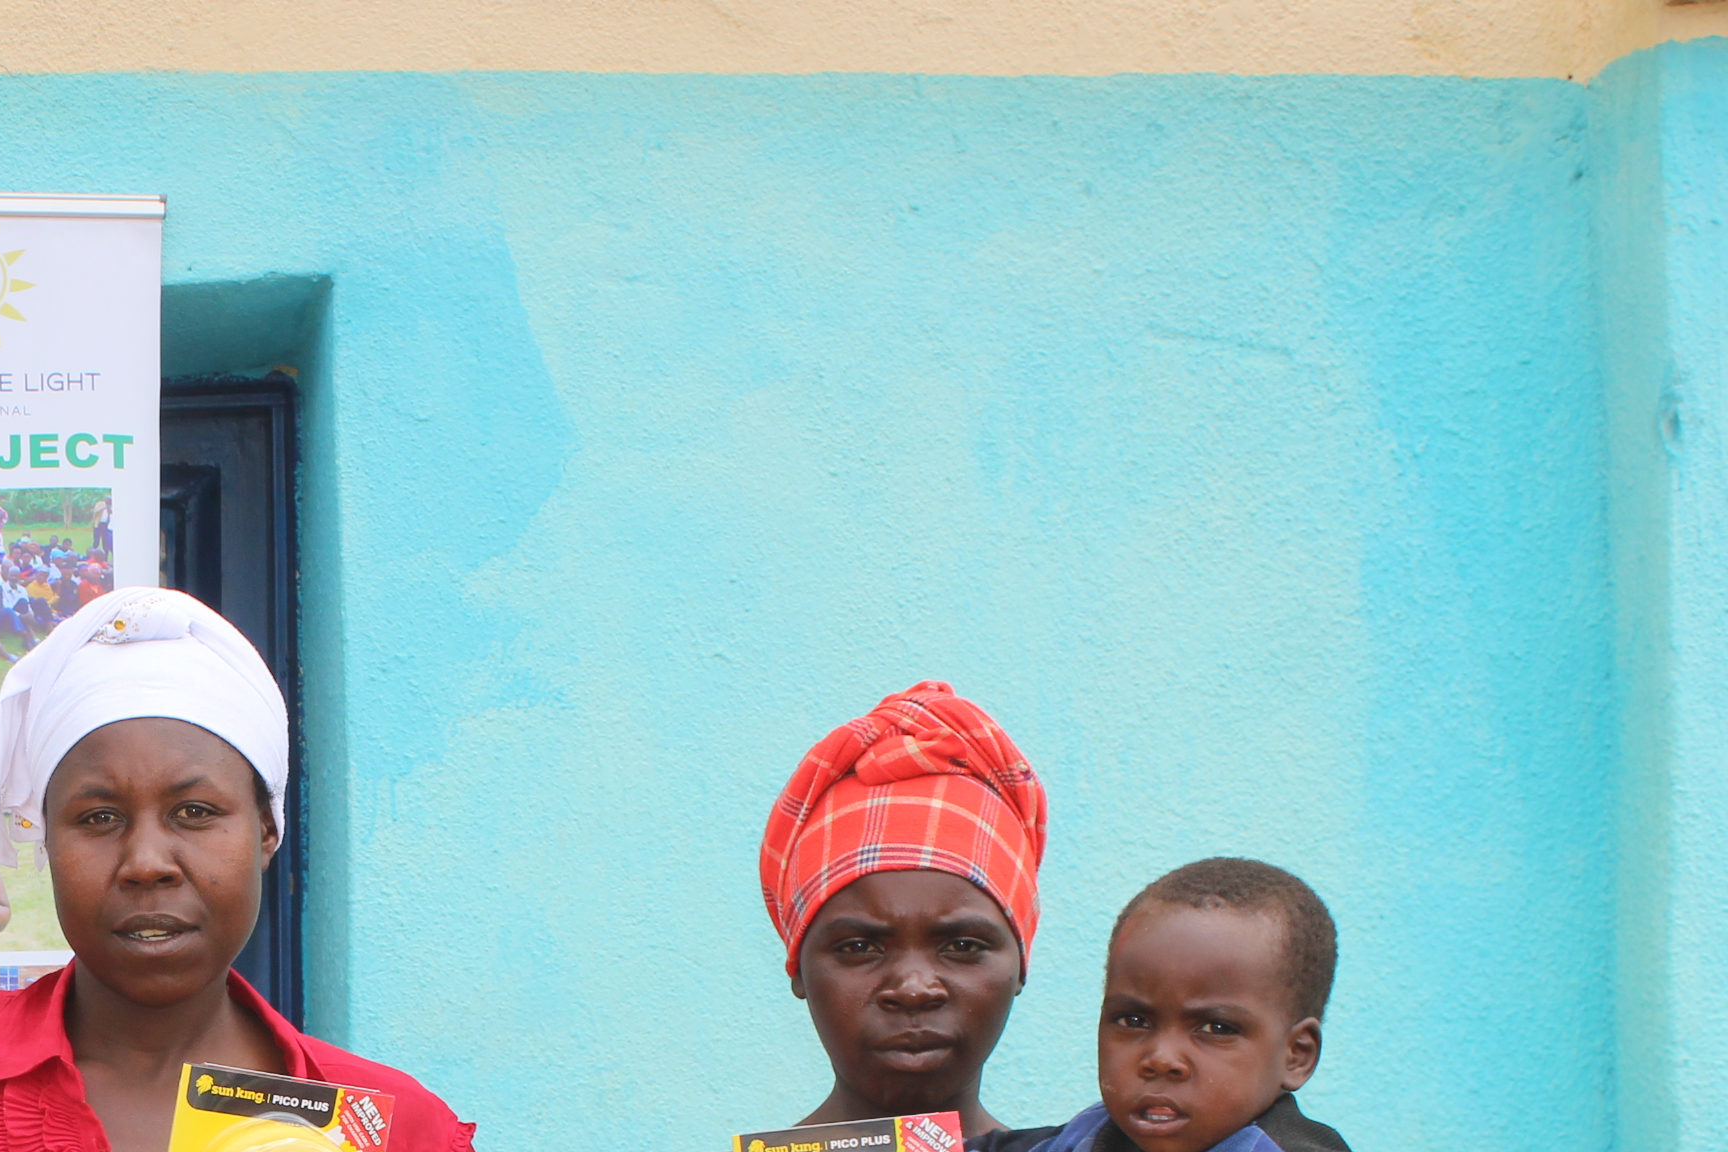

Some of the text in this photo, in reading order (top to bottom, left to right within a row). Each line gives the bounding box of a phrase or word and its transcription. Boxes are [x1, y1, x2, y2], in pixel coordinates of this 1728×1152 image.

[24, 372, 102, 393] LIGHT
[211, 1084, 330, 1112] sun king PICO PLUS
[358, 1095, 387, 1131] NEW
[351, 1101, 382, 1146] IMPROVED
[919, 1116, 957, 1149] NEW
[829, 1138, 859, 1150] PICO
[860, 1134, 891, 1147] PLUS
